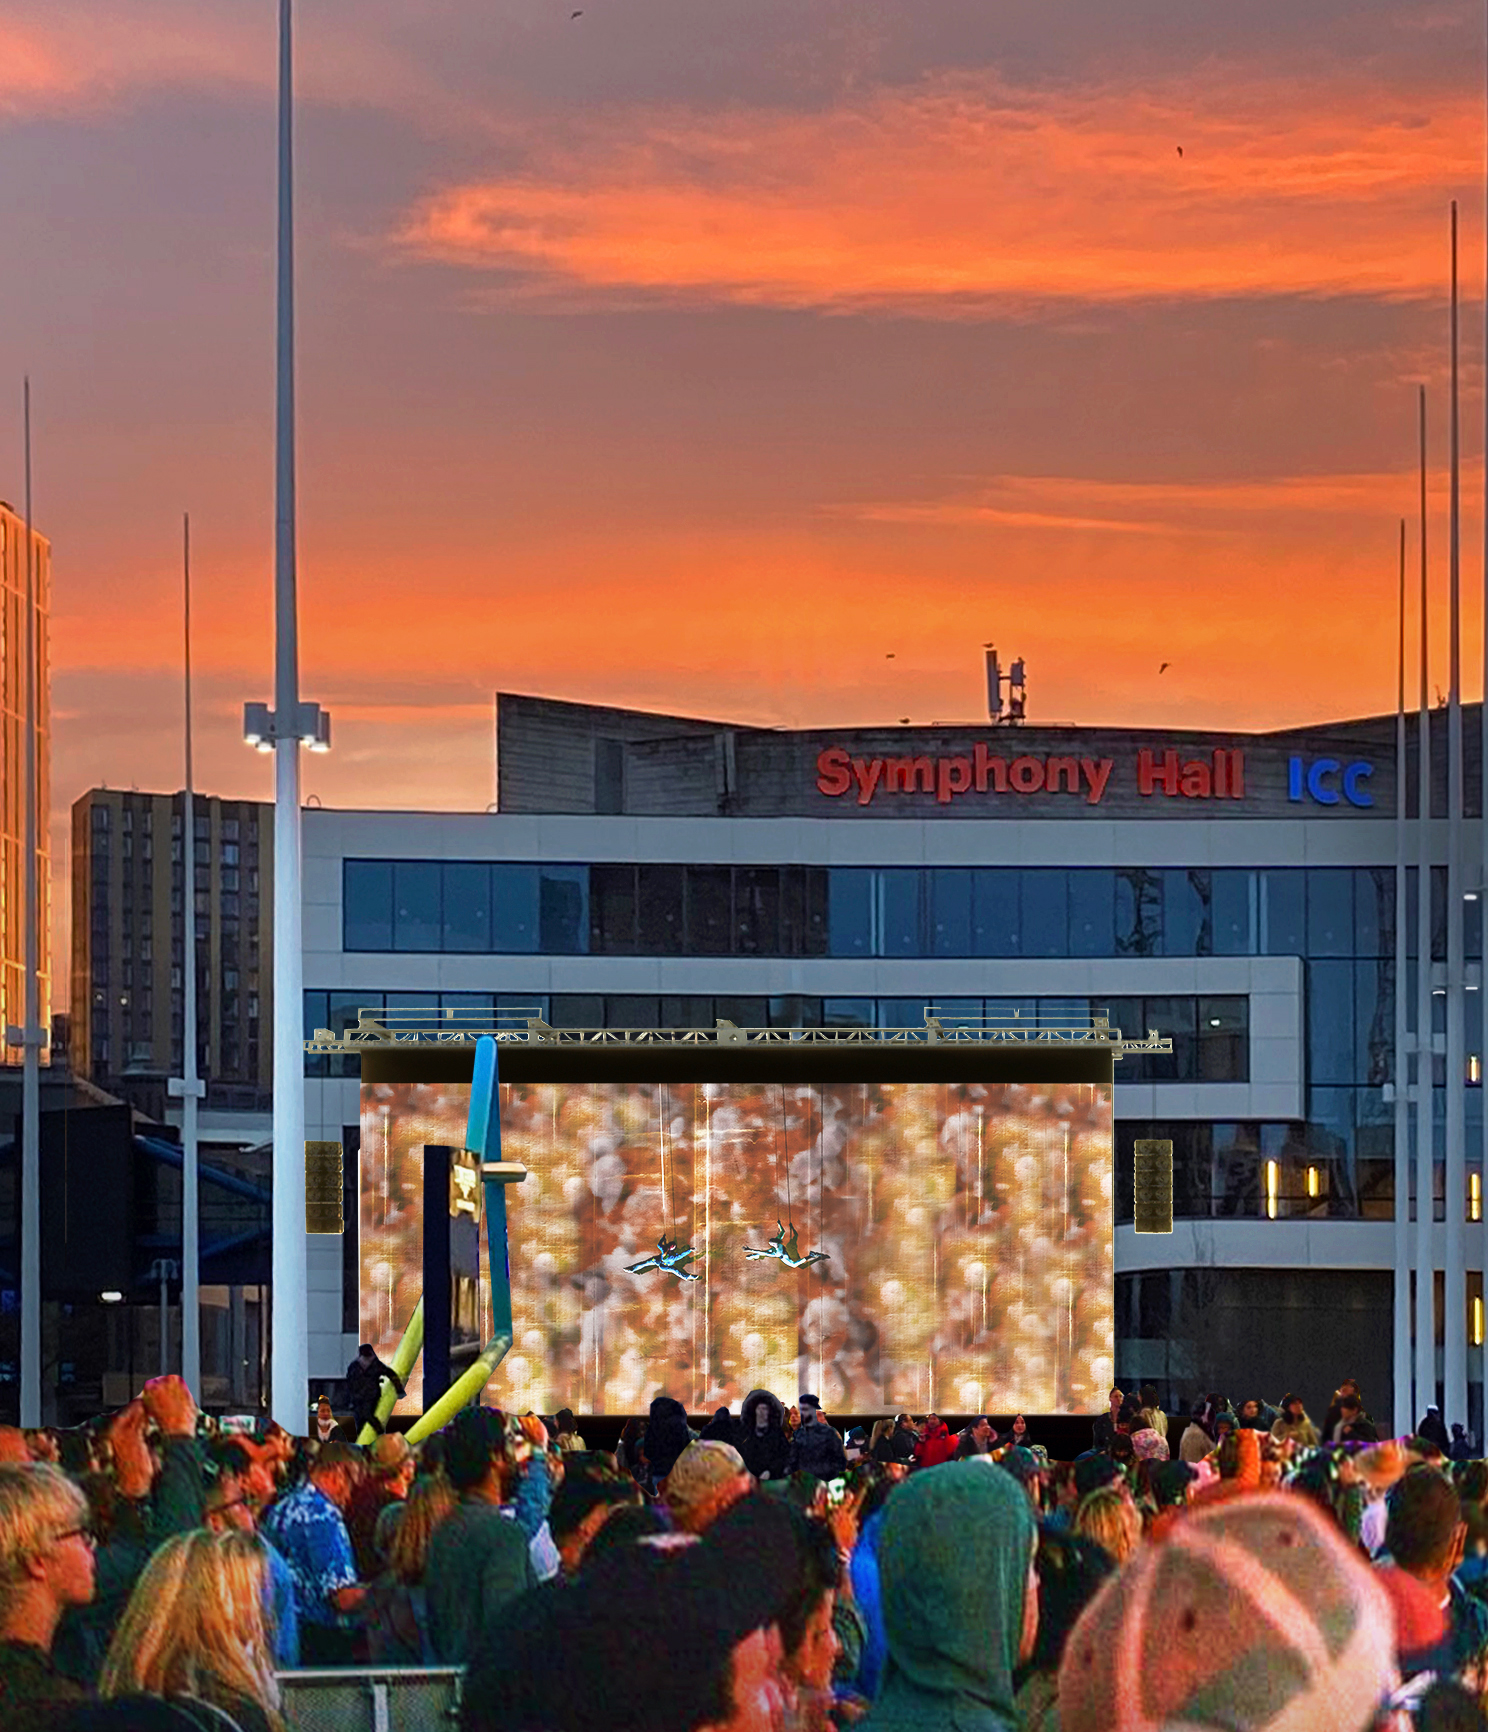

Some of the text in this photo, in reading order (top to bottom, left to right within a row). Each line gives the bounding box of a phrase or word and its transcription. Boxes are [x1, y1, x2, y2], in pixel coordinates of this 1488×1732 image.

[816, 742, 1375, 807] Symphony Hall ICC
